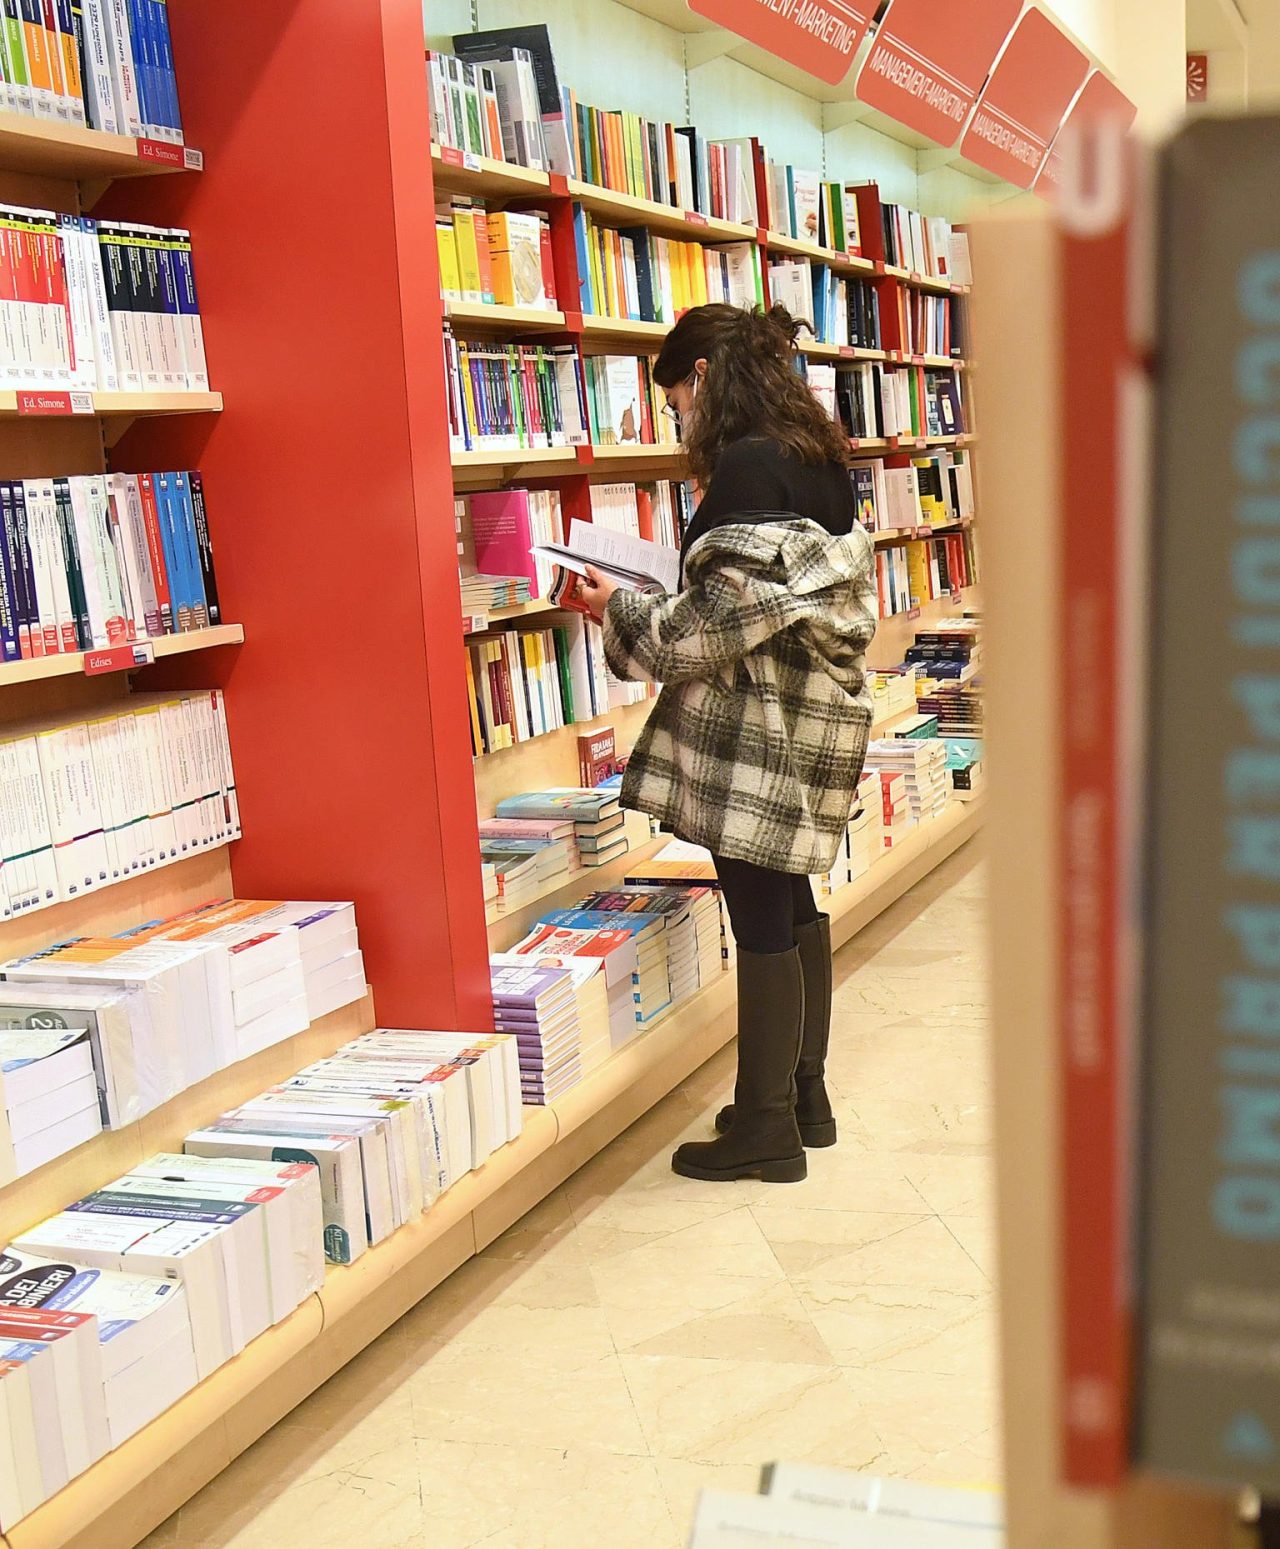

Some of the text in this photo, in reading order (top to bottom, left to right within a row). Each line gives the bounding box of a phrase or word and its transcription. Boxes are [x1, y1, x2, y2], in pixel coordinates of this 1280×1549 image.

[870, 46, 967, 122] MANAGEMENT-MARKETING
[143, 144, 179, 161] Ed. Simone
[24, 397, 65, 409] Ed. Simone
[90, 658, 112, 669] Edises
[5, 1279, 39, 1299] DEI
[17, 1269, 72, 1307] BINIERI
